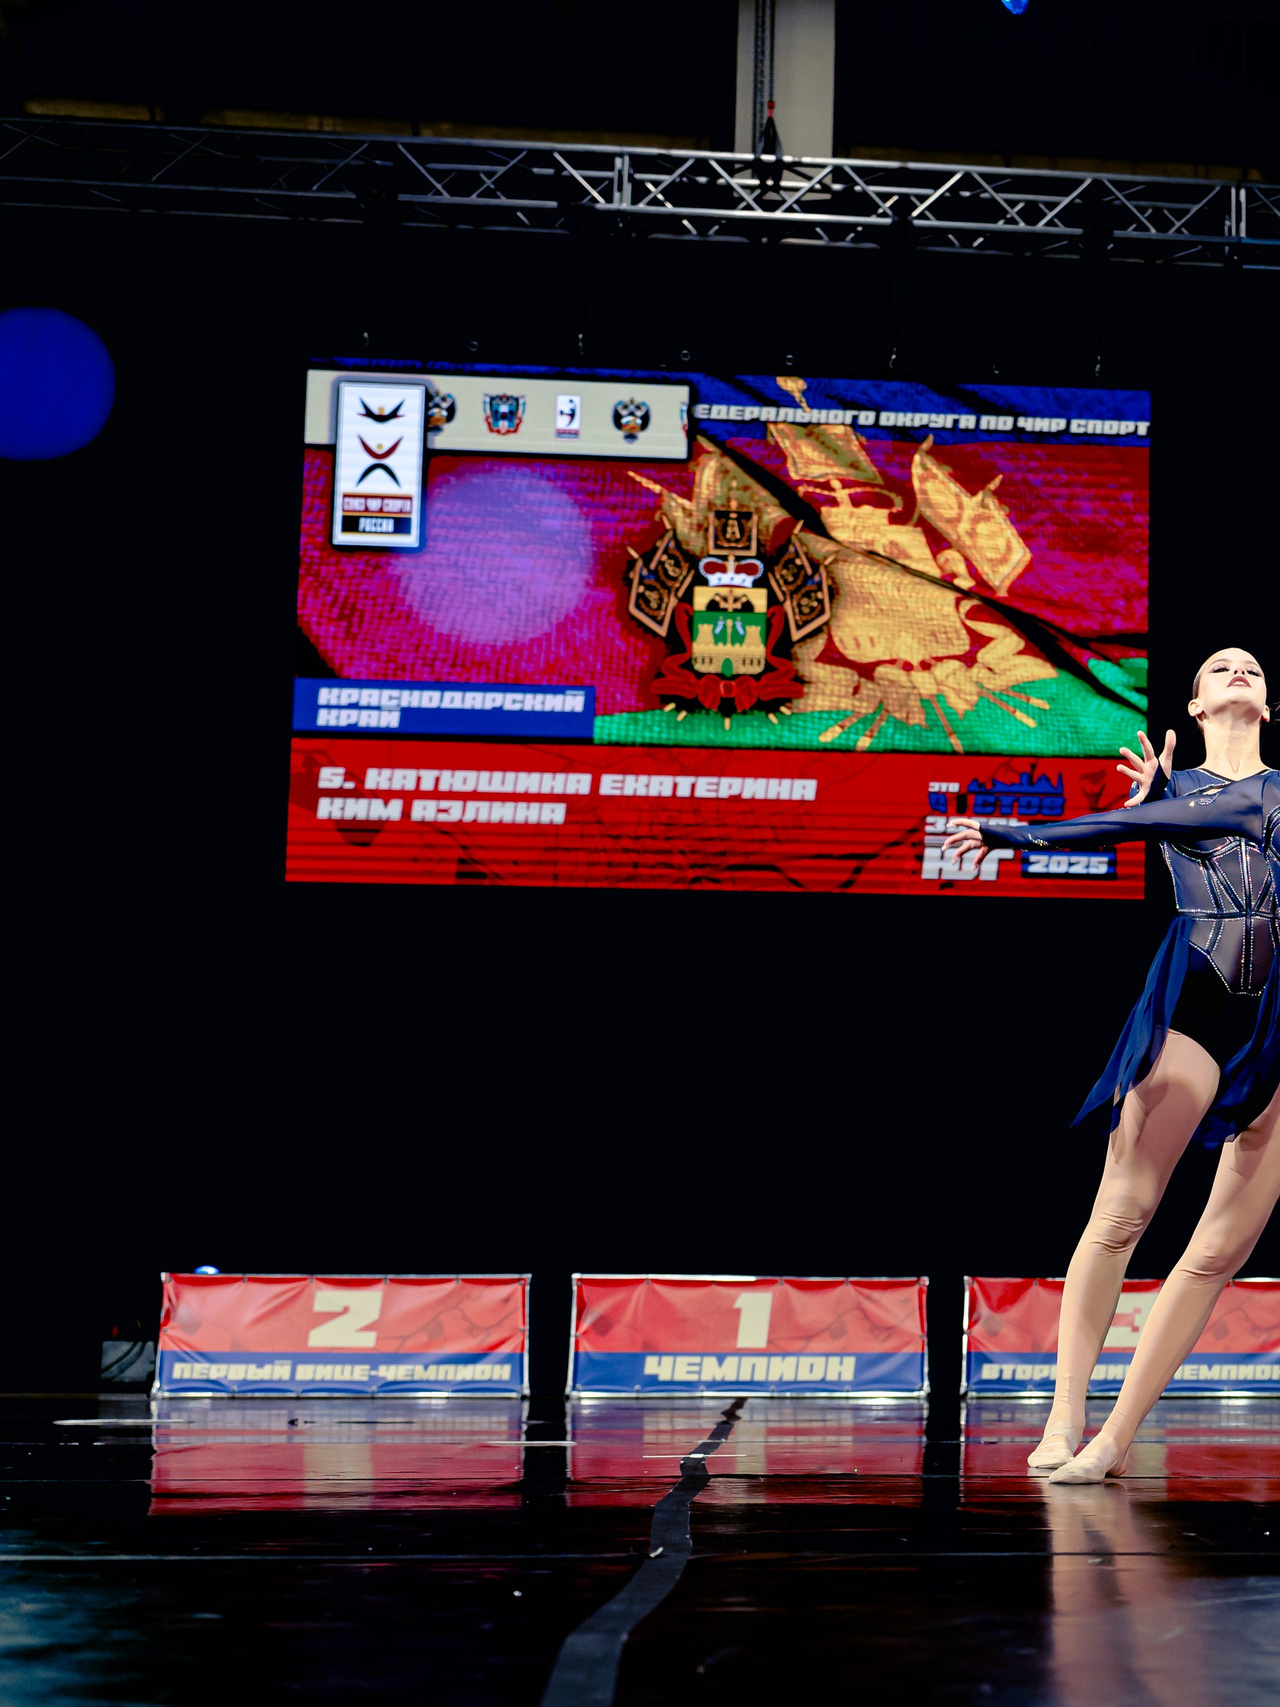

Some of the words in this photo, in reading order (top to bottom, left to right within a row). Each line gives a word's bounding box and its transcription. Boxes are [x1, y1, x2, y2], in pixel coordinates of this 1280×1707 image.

[693, 404, 876, 426] ЕДЕРАЛЬНОГО
[879, 411, 976, 430] ОКРУГА
[979, 415, 1014, 431] ПО
[1017, 416, 1067, 432] ЧИР
[1070, 418, 1150, 436] СПОРТ
[318, 687, 585, 713] КРАСНОДАРСКИЙ
[316, 705, 400, 728] КРАЙ
[317, 766, 355, 790] 5.
[364, 767, 592, 795] КАТЮШИНА
[599, 773, 817, 801] ЕКАТЕРИНА
[928, 781, 960, 793] ЭТО
[316, 797, 403, 821] КИМ
[410, 799, 567, 825] АЭЛИНА
[1028, 855, 1109, 875] 2025
[307, 1290, 383, 1348] 2
[733, 1292, 773, 1349] 1
[172, 1360, 292, 1381] ПЕРВЫЙ
[295, 1363, 511, 1381] ВИЦЕ-ЧЕМПИОН
[643, 1355, 856, 1382] ЧЕМПИОН
[981, 1363, 1057, 1381] ВТОР
